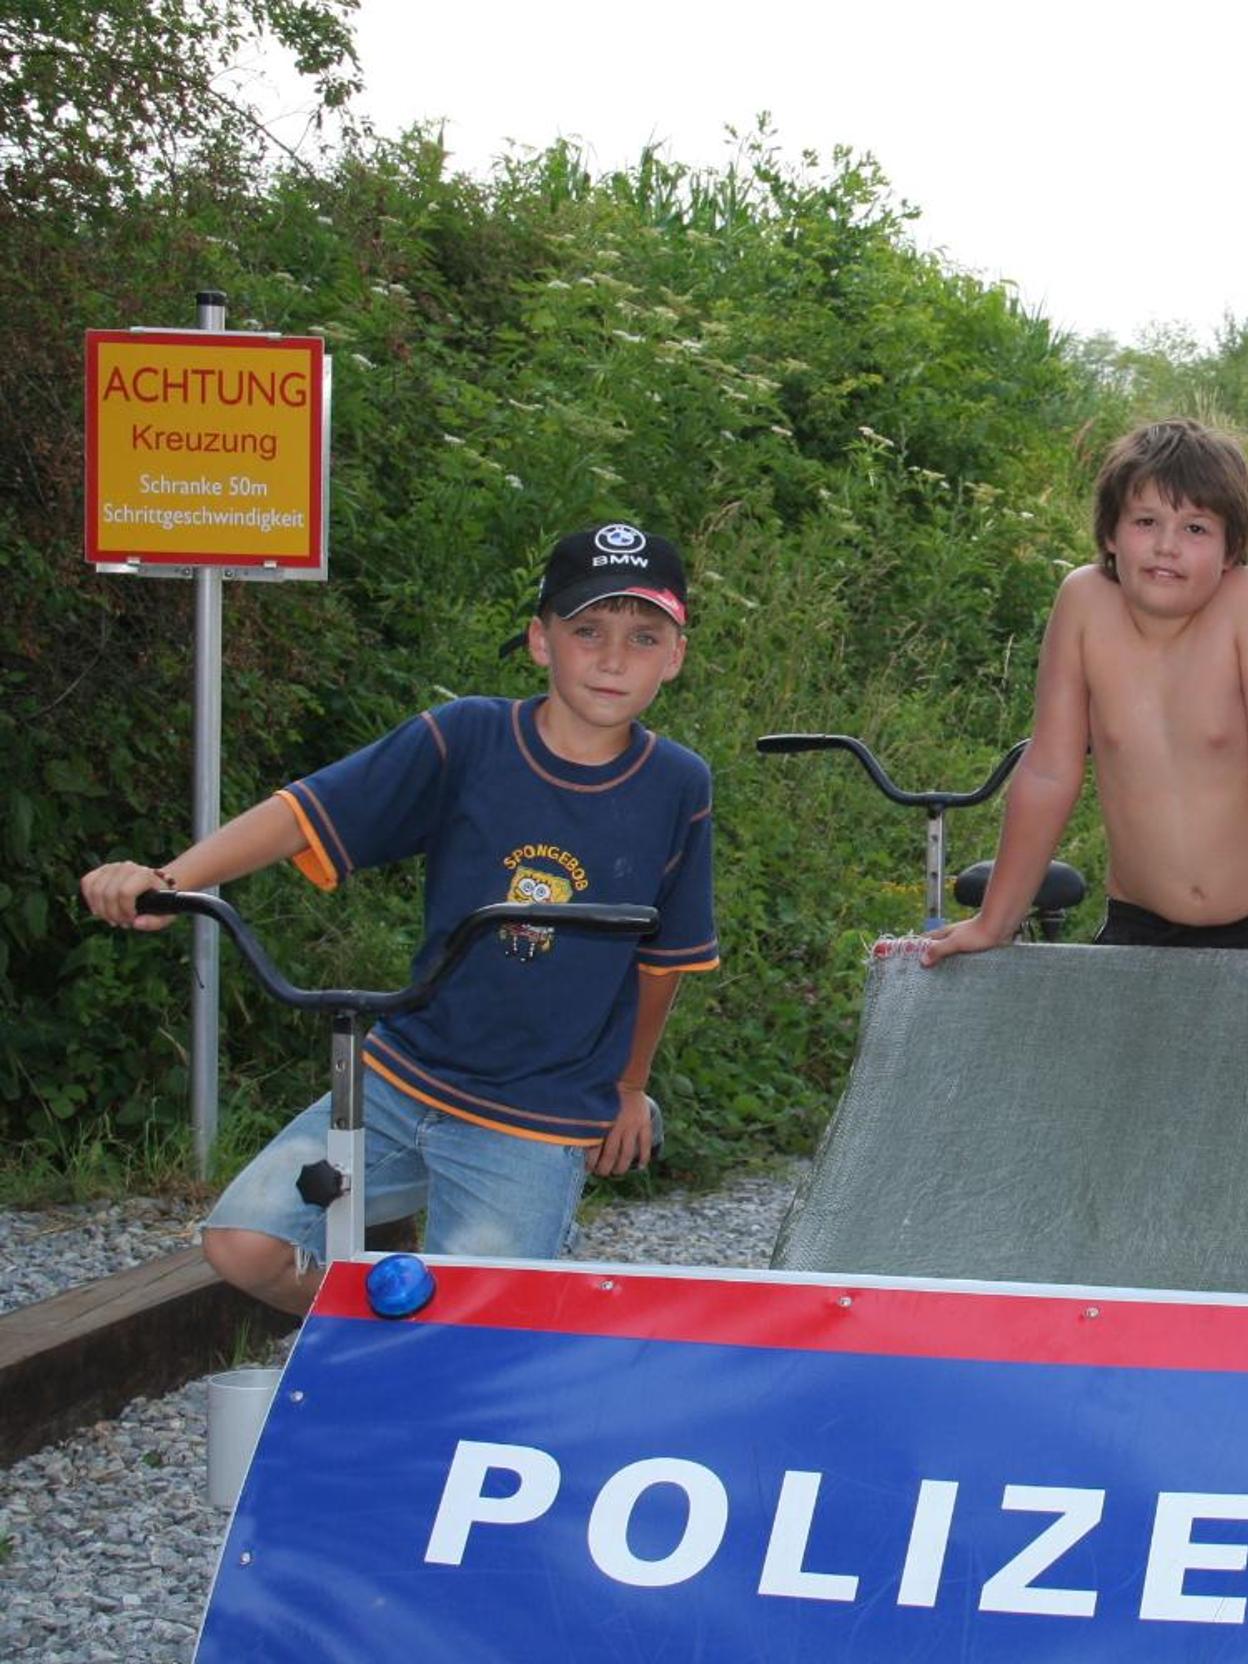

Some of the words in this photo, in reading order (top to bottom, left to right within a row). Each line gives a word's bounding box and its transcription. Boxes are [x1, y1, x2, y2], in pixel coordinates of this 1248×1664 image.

[103, 366, 308, 408] ACHTUNG
[132, 424, 278, 461] Kreuzung
[139, 473, 222, 496] Schranke
[229, 475, 268, 497] 50m
[103, 503, 305, 533] Schrittgeschwindigkeit
[592, 554, 649, 568] BMW
[503, 844, 589, 892] SPONGEBOB
